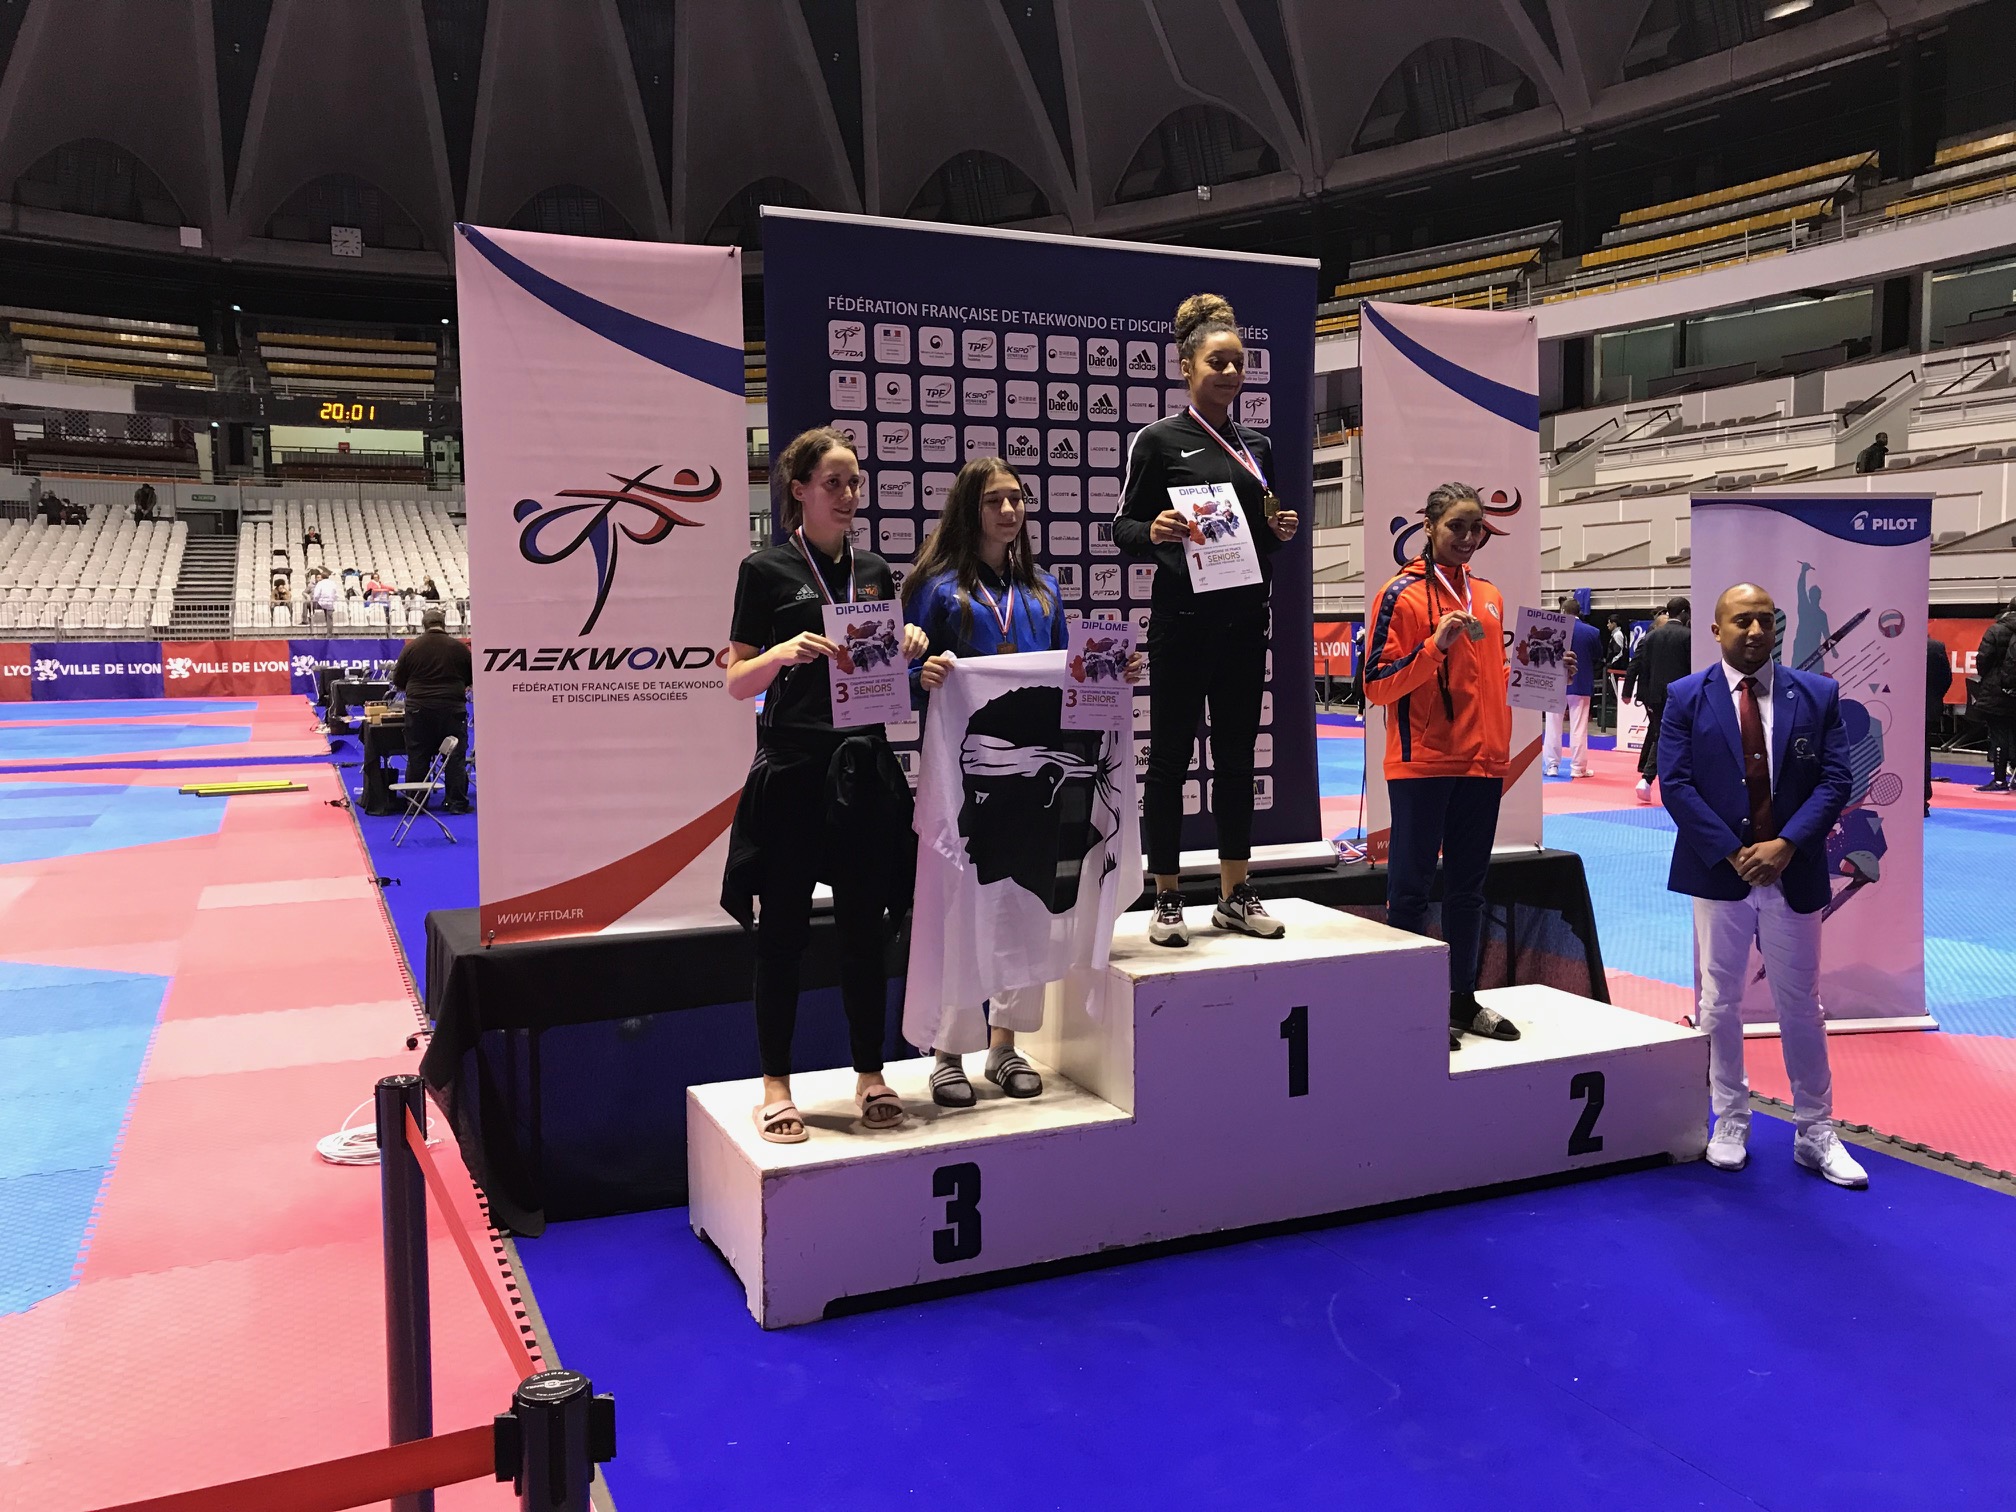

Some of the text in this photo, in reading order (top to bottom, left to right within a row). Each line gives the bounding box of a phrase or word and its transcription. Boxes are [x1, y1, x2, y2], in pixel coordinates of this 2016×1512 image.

[828, 294, 1269, 340] FÉDÉRATION FRANÇAISE DE TAEKWONDO ET DISCIPL CIÉES
[968, 342, 987, 352] TPF
[1006, 346, 1029, 354] KSPO
[831, 349, 864, 358] FFTDA
[1128, 362, 1156, 371] adidas
[925, 388, 946, 398] TPF
[965, 391, 988, 400] KSPO
[320, 402, 375, 421] 20:01
[1089, 405, 1118, 415] adidas
[882, 434, 903, 444] TPF
[923, 437, 946, 445] KSPO
[1050, 451, 1079, 460] adidas
[880, 483, 904, 492] KSPO
[1179, 486, 1223, 496] DIPLOME
[1023, 495, 1039, 505] das
[1872, 518, 1918, 531] PILOT
[1192, 552, 1203, 570] 1
[1208, 551, 1240, 563] SENIORS
[795, 593, 819, 601] adidas
[836, 603, 889, 615] DIPLOME
[1527, 609, 1566, 624] DIPLOME
[1082, 621, 1128, 632] DIPLOME
[1320, 641, 1350, 657] LYON
[3, 664, 31, 676] LYO
[59, 662, 162, 676] VILLE DE LYON
[192, 660, 289, 674] VILLE DE LYON
[1511, 669, 1522, 687] 2
[1525, 676, 1553, 688] SENIORS
[512, 680, 724, 692] FÉDÉRATION FRANÇAISE DE TAEKWONDO
[854, 683, 892, 695] SENIORS
[552, 691, 688, 703] ET DISCIPLINES ASSOCIÉES
[836, 682, 850, 703] 3
[1065, 688, 1078, 708] 3
[1082, 694, 1116, 704] SENIORS
[497, 908, 584, 925] WWW.FFTDA.FR
[1280, 1006, 1310, 1098] 1
[1567, 1069, 1606, 1157] 2
[931, 1161, 982, 1266] 3
